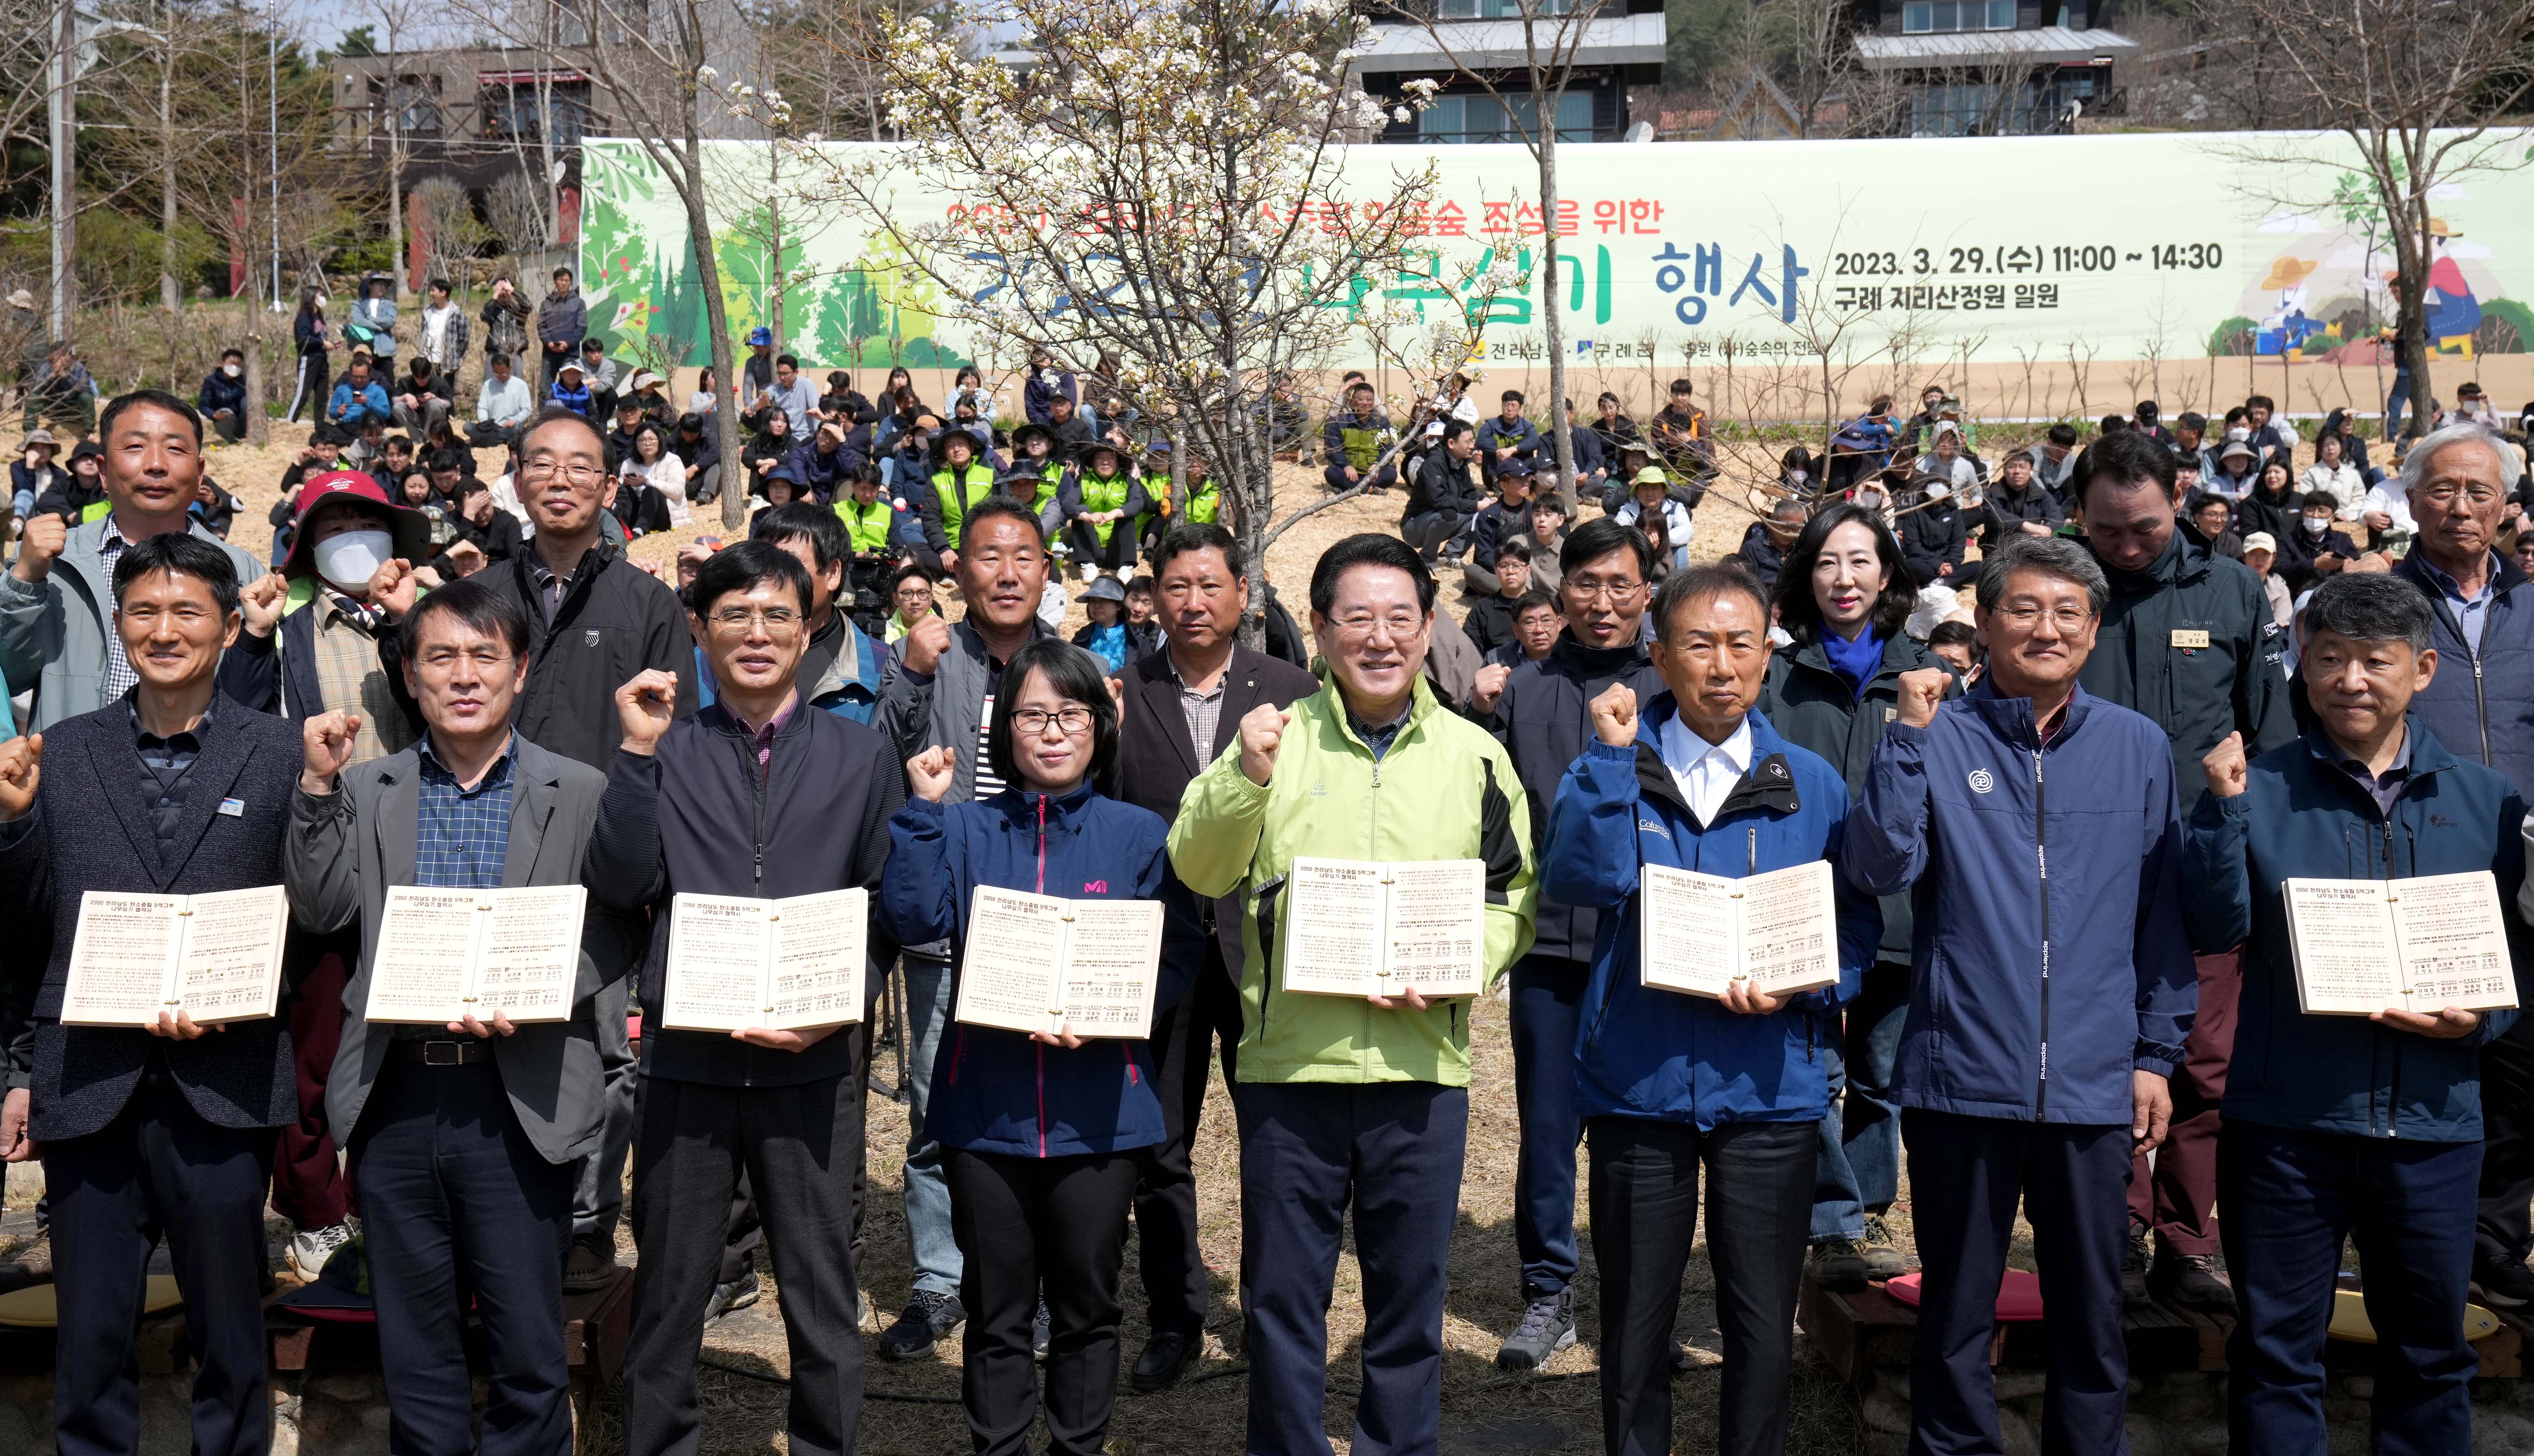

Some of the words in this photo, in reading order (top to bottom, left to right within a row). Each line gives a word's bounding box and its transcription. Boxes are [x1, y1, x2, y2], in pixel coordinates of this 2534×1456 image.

[1480, 200, 1580, 235] 조성을
[1594, 198, 1664, 234] 위한
[1835, 252, 1904, 275] 2023.
[1913, 248, 1937, 274] 3.
[2053, 245, 2116, 271] 11:00
[2151, 243, 2222, 270] 14:30
[1653, 242, 1809, 324] 행사
[1835, 286, 1881, 311] 구례
[1890, 284, 2005, 310] 지리산정원
[2015, 283, 2058, 308] 일원
[1639, 819, 1670, 839] Columbia
[2038, 845, 2047, 879] applerind
